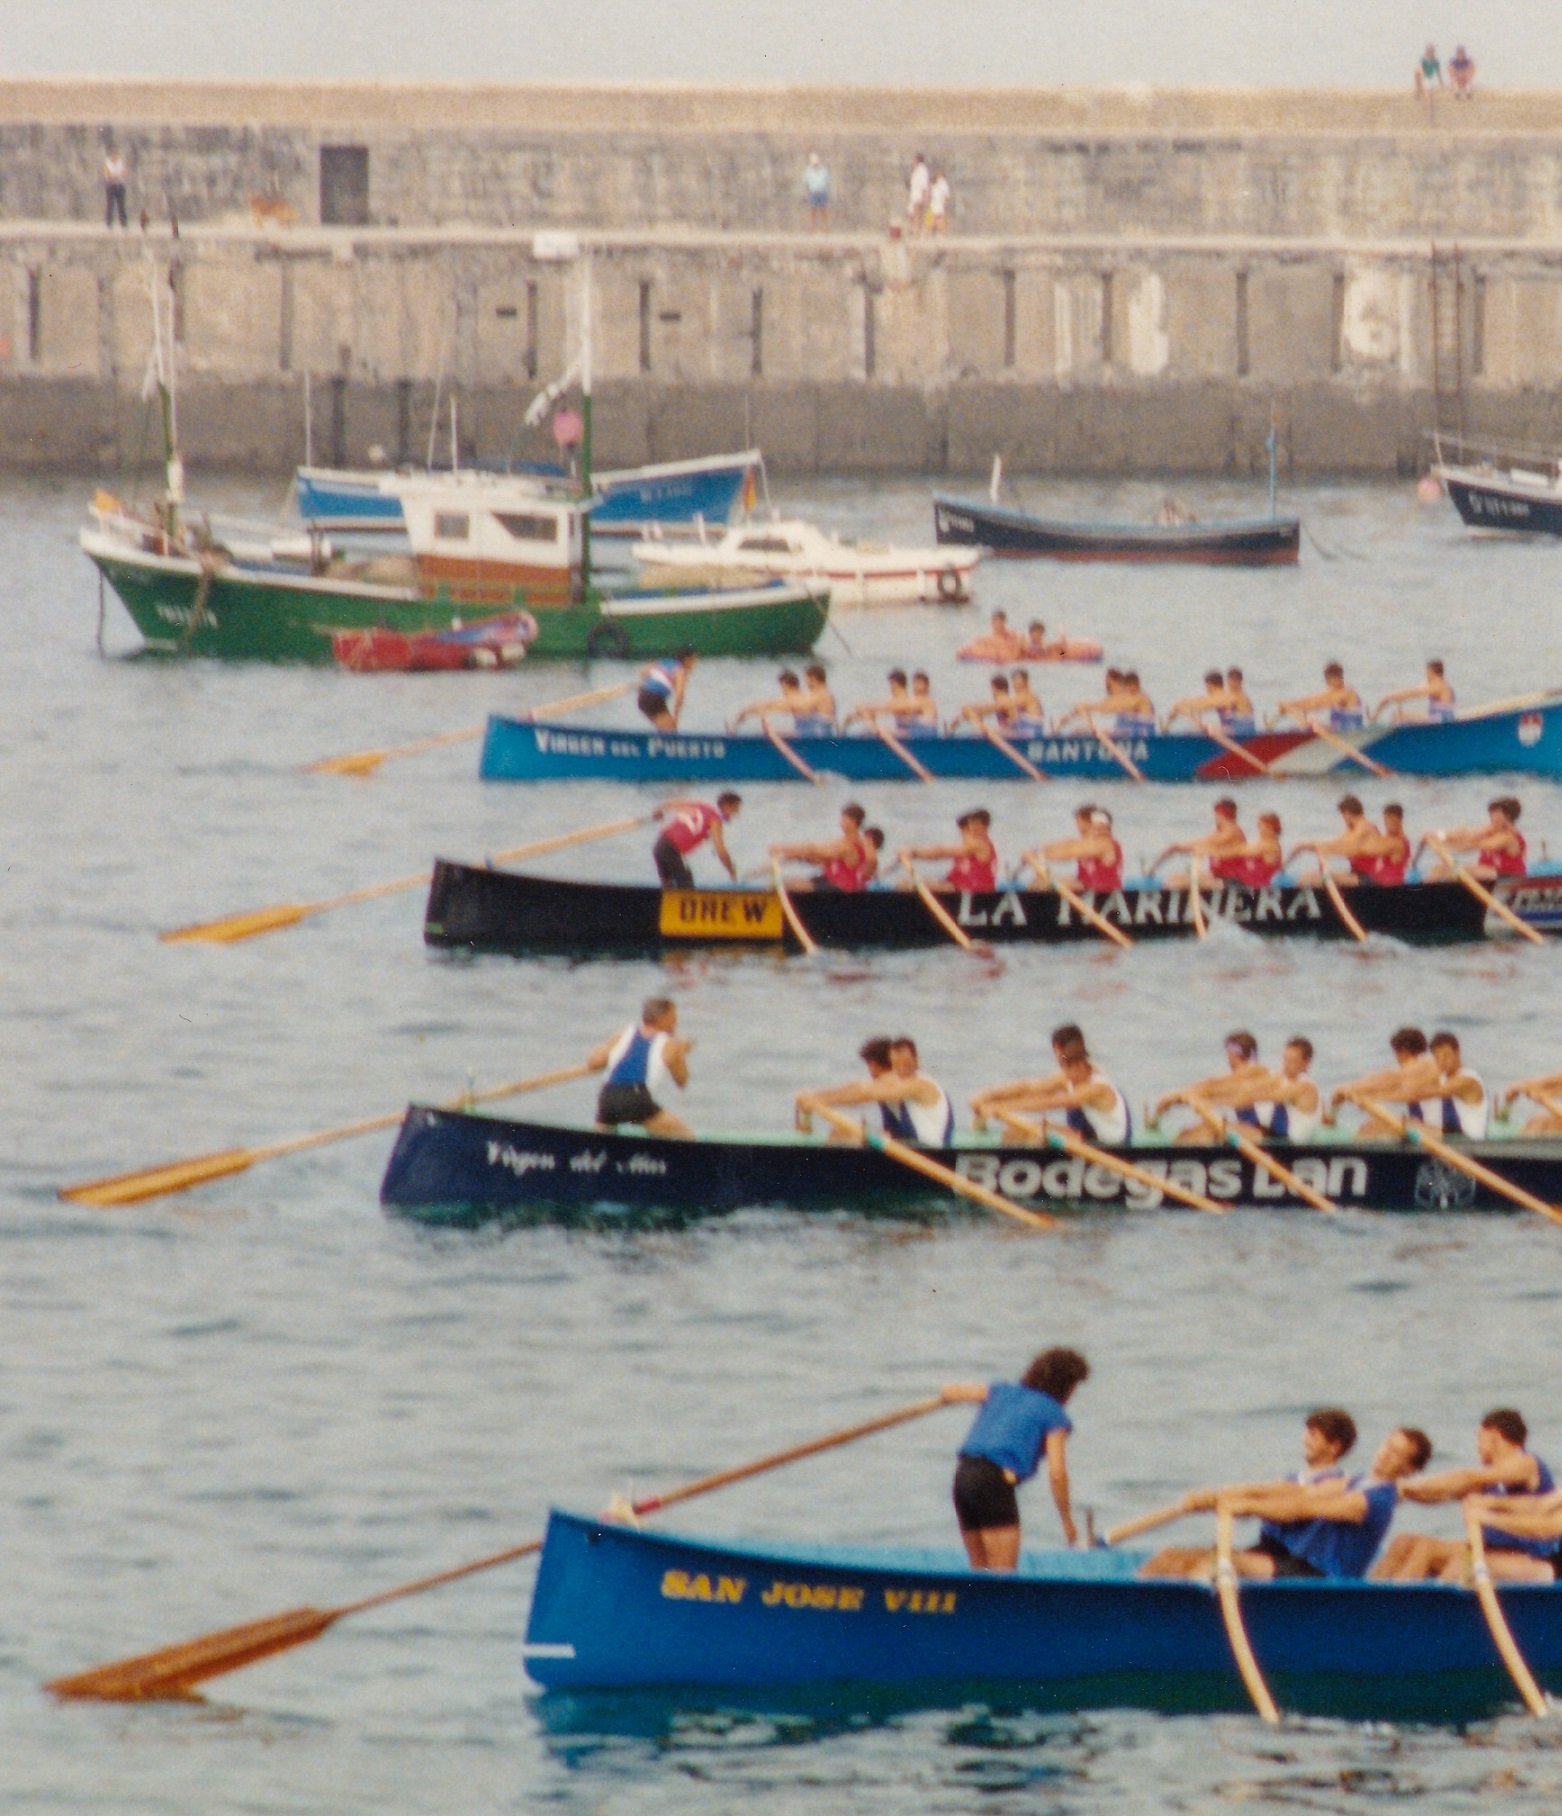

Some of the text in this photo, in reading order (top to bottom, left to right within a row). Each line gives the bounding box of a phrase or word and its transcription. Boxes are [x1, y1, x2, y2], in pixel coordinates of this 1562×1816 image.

[957, 884, 1323, 926] LA MARINERA
[954, 1153, 1243, 1210] Bodegas
[661, 1568, 958, 1614] SAN JOSE VIII
